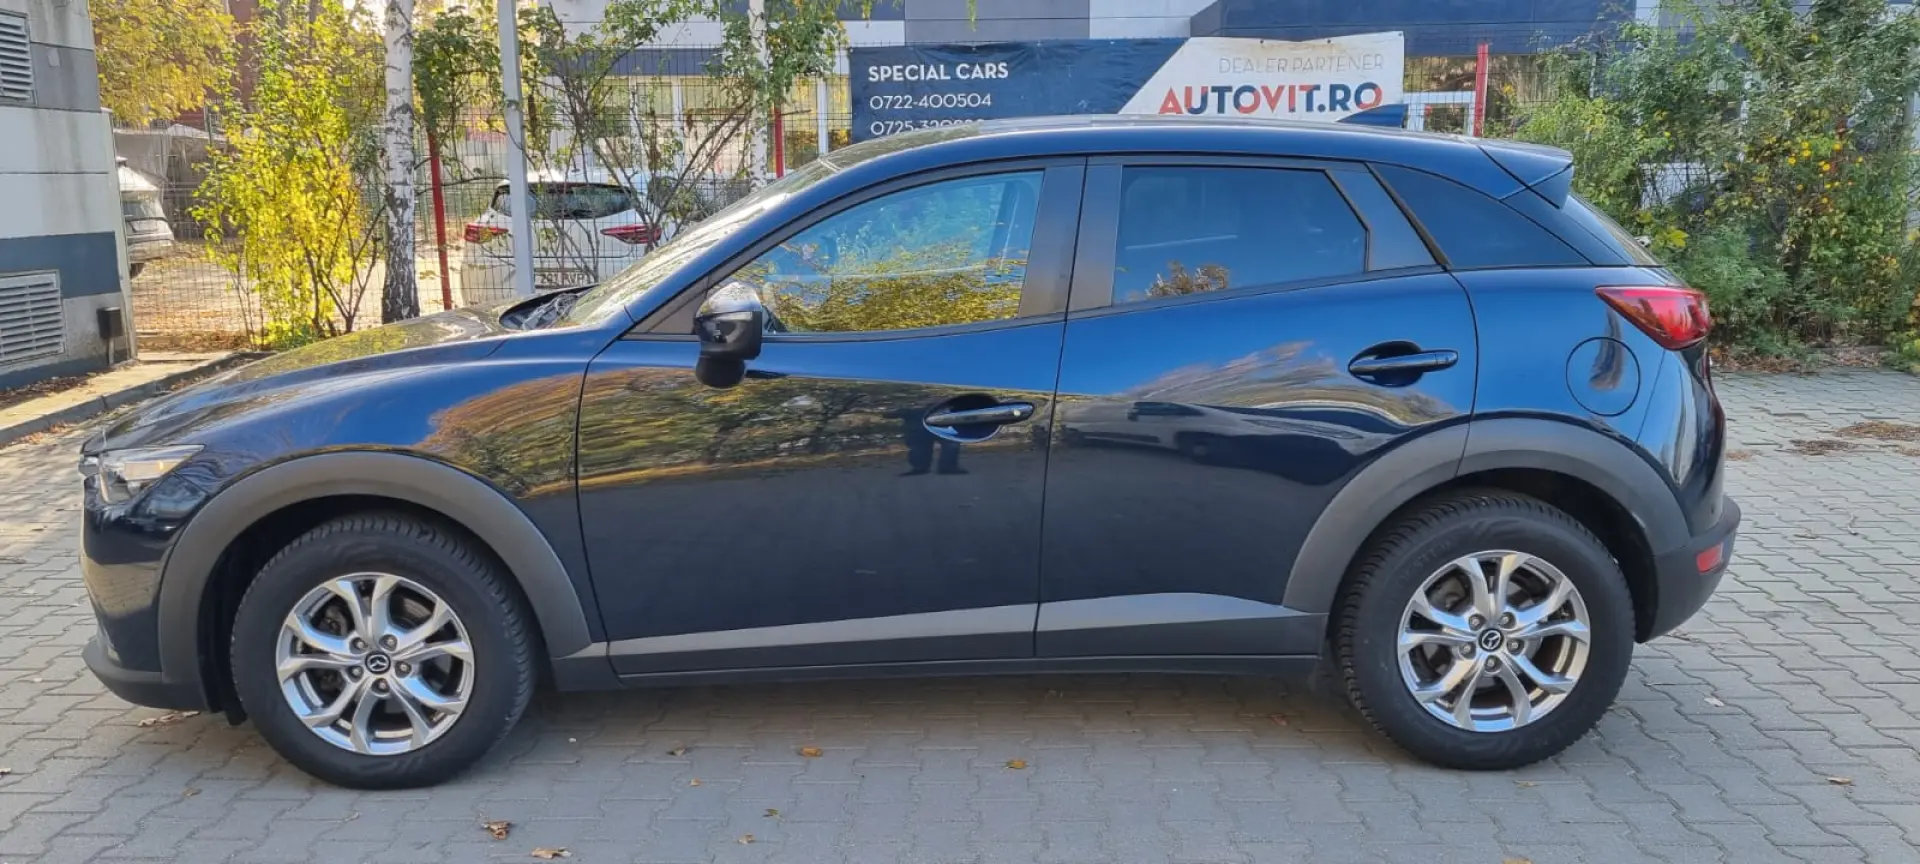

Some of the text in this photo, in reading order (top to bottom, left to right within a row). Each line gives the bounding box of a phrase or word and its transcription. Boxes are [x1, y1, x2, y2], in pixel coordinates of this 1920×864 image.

[868, 62, 1009, 82] SPECIAL CARS
[1218, 53, 1384, 74] DEALER PARTENER
[869, 92, 992, 110] 0722-400504
[1158, 82, 1383, 115] AUTOVIT.RO
